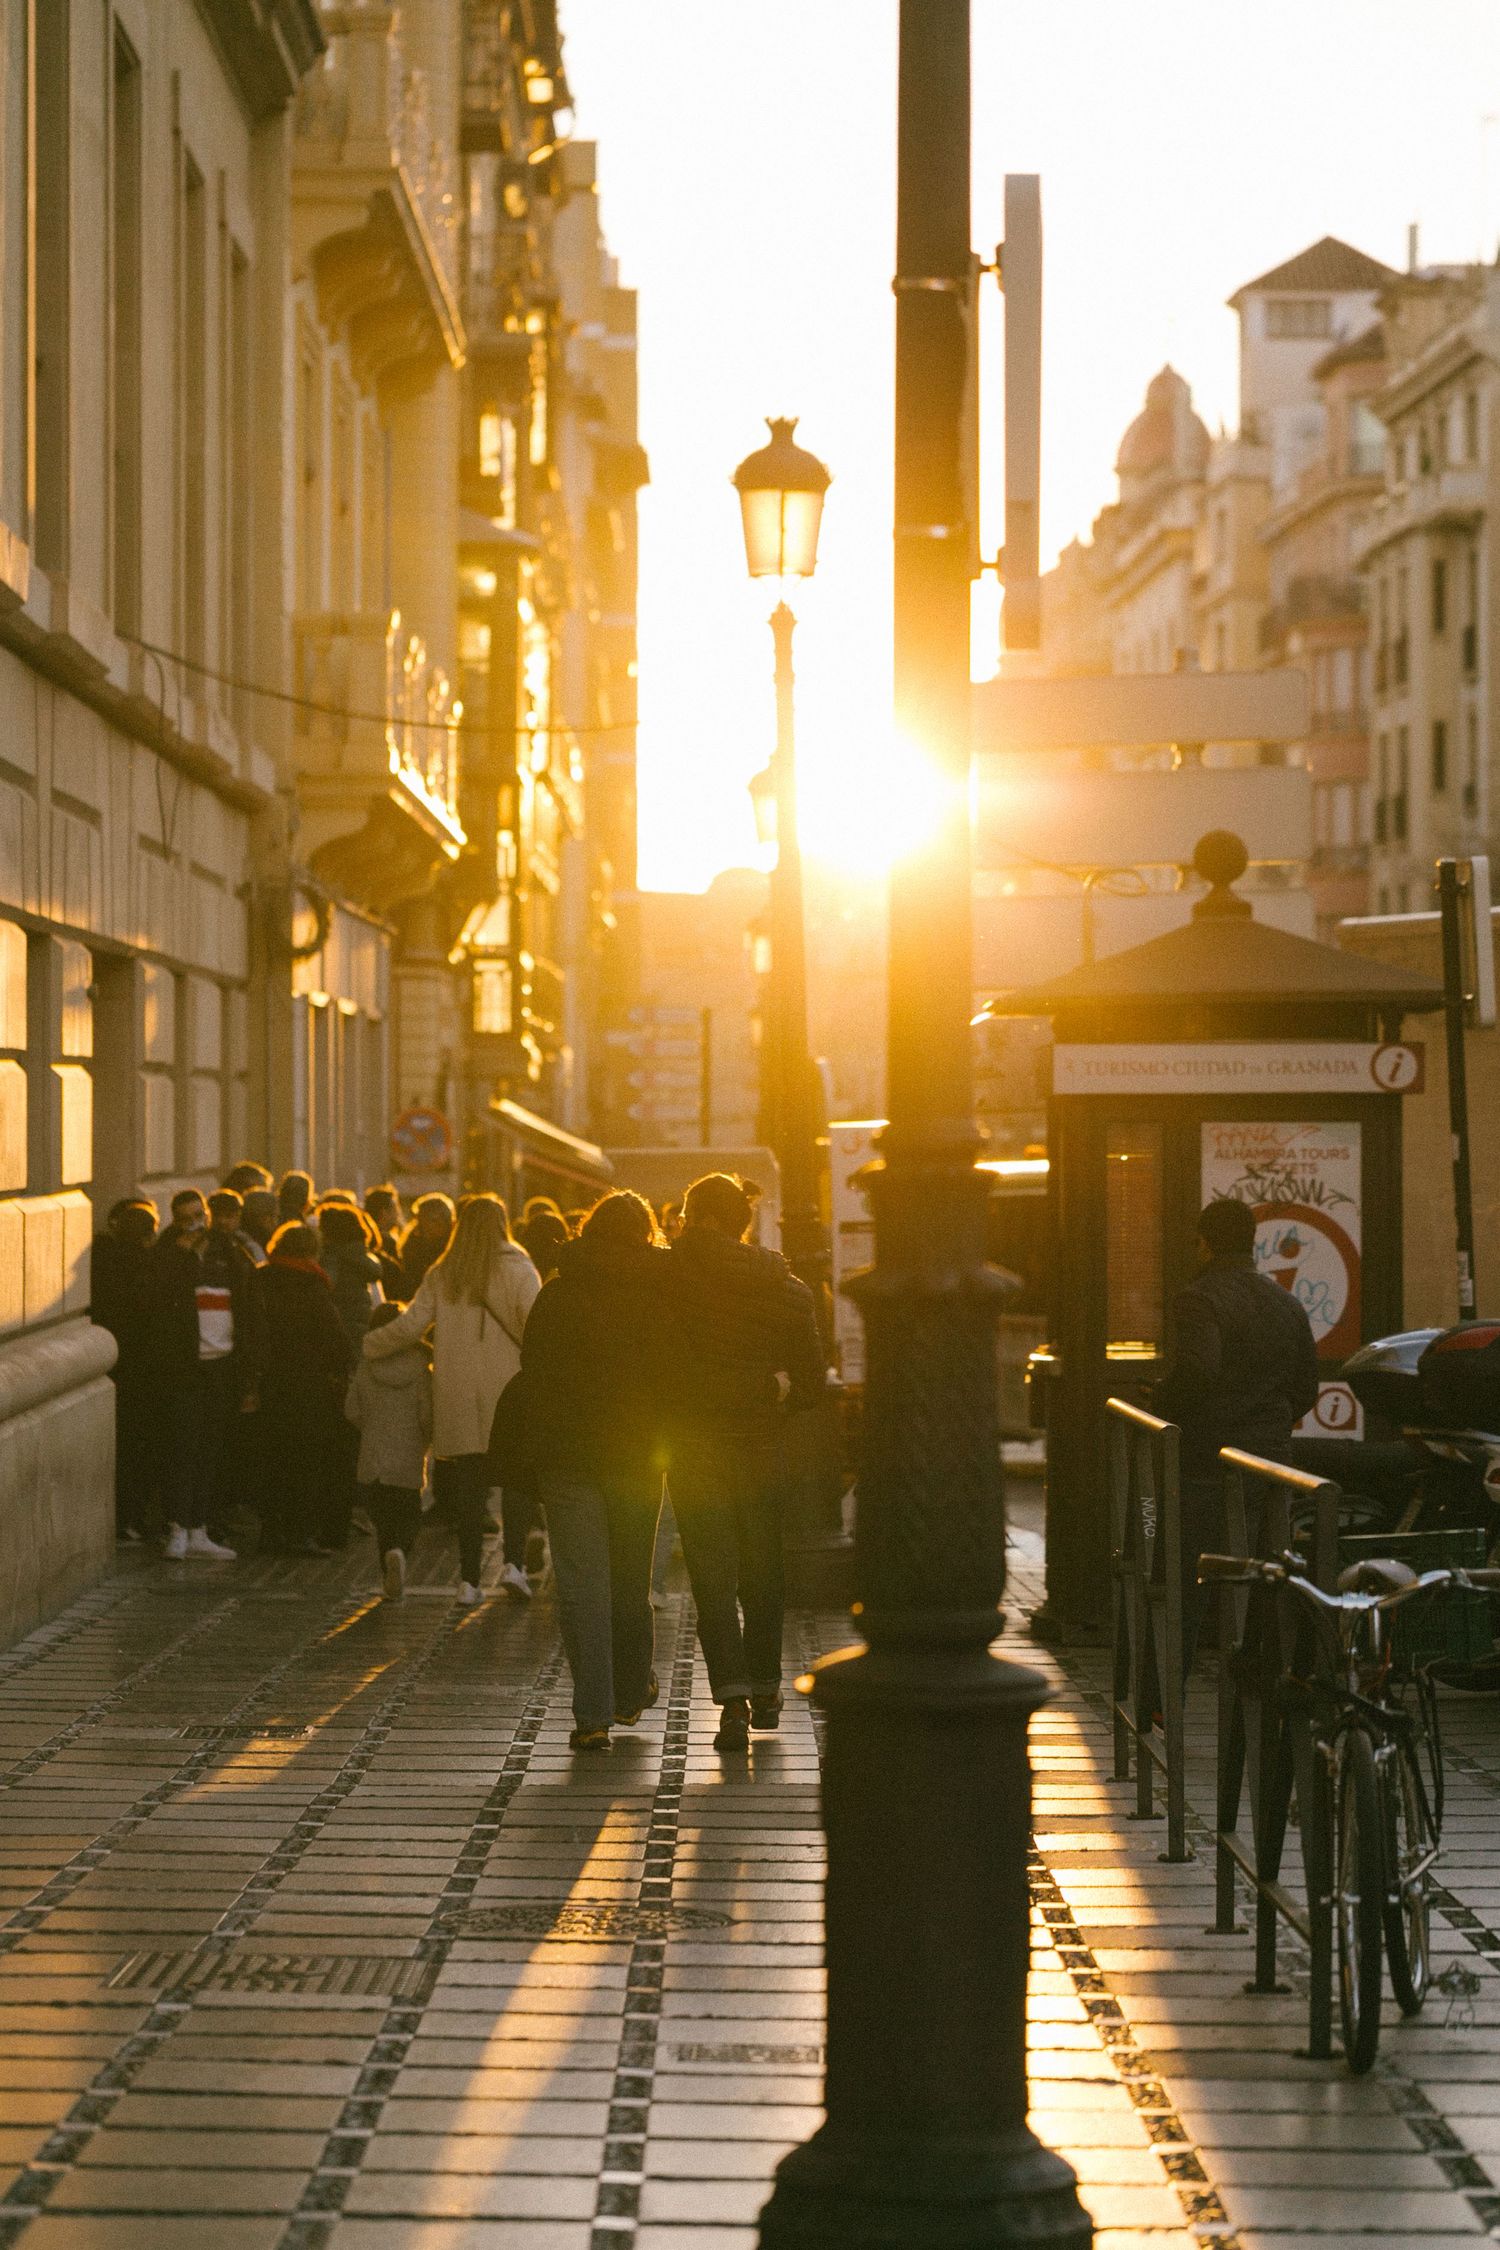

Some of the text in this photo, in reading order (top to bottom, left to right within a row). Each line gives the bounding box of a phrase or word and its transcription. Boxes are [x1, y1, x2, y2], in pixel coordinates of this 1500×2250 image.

[1084, 1060, 1169, 1076] TURISMO
[1171, 1060, 1247, 1076] CIUDAD
[1266, 1059, 1360, 1076] GRANADA
[1214, 1146, 1350, 1160] ALHAMBRA TOURS
